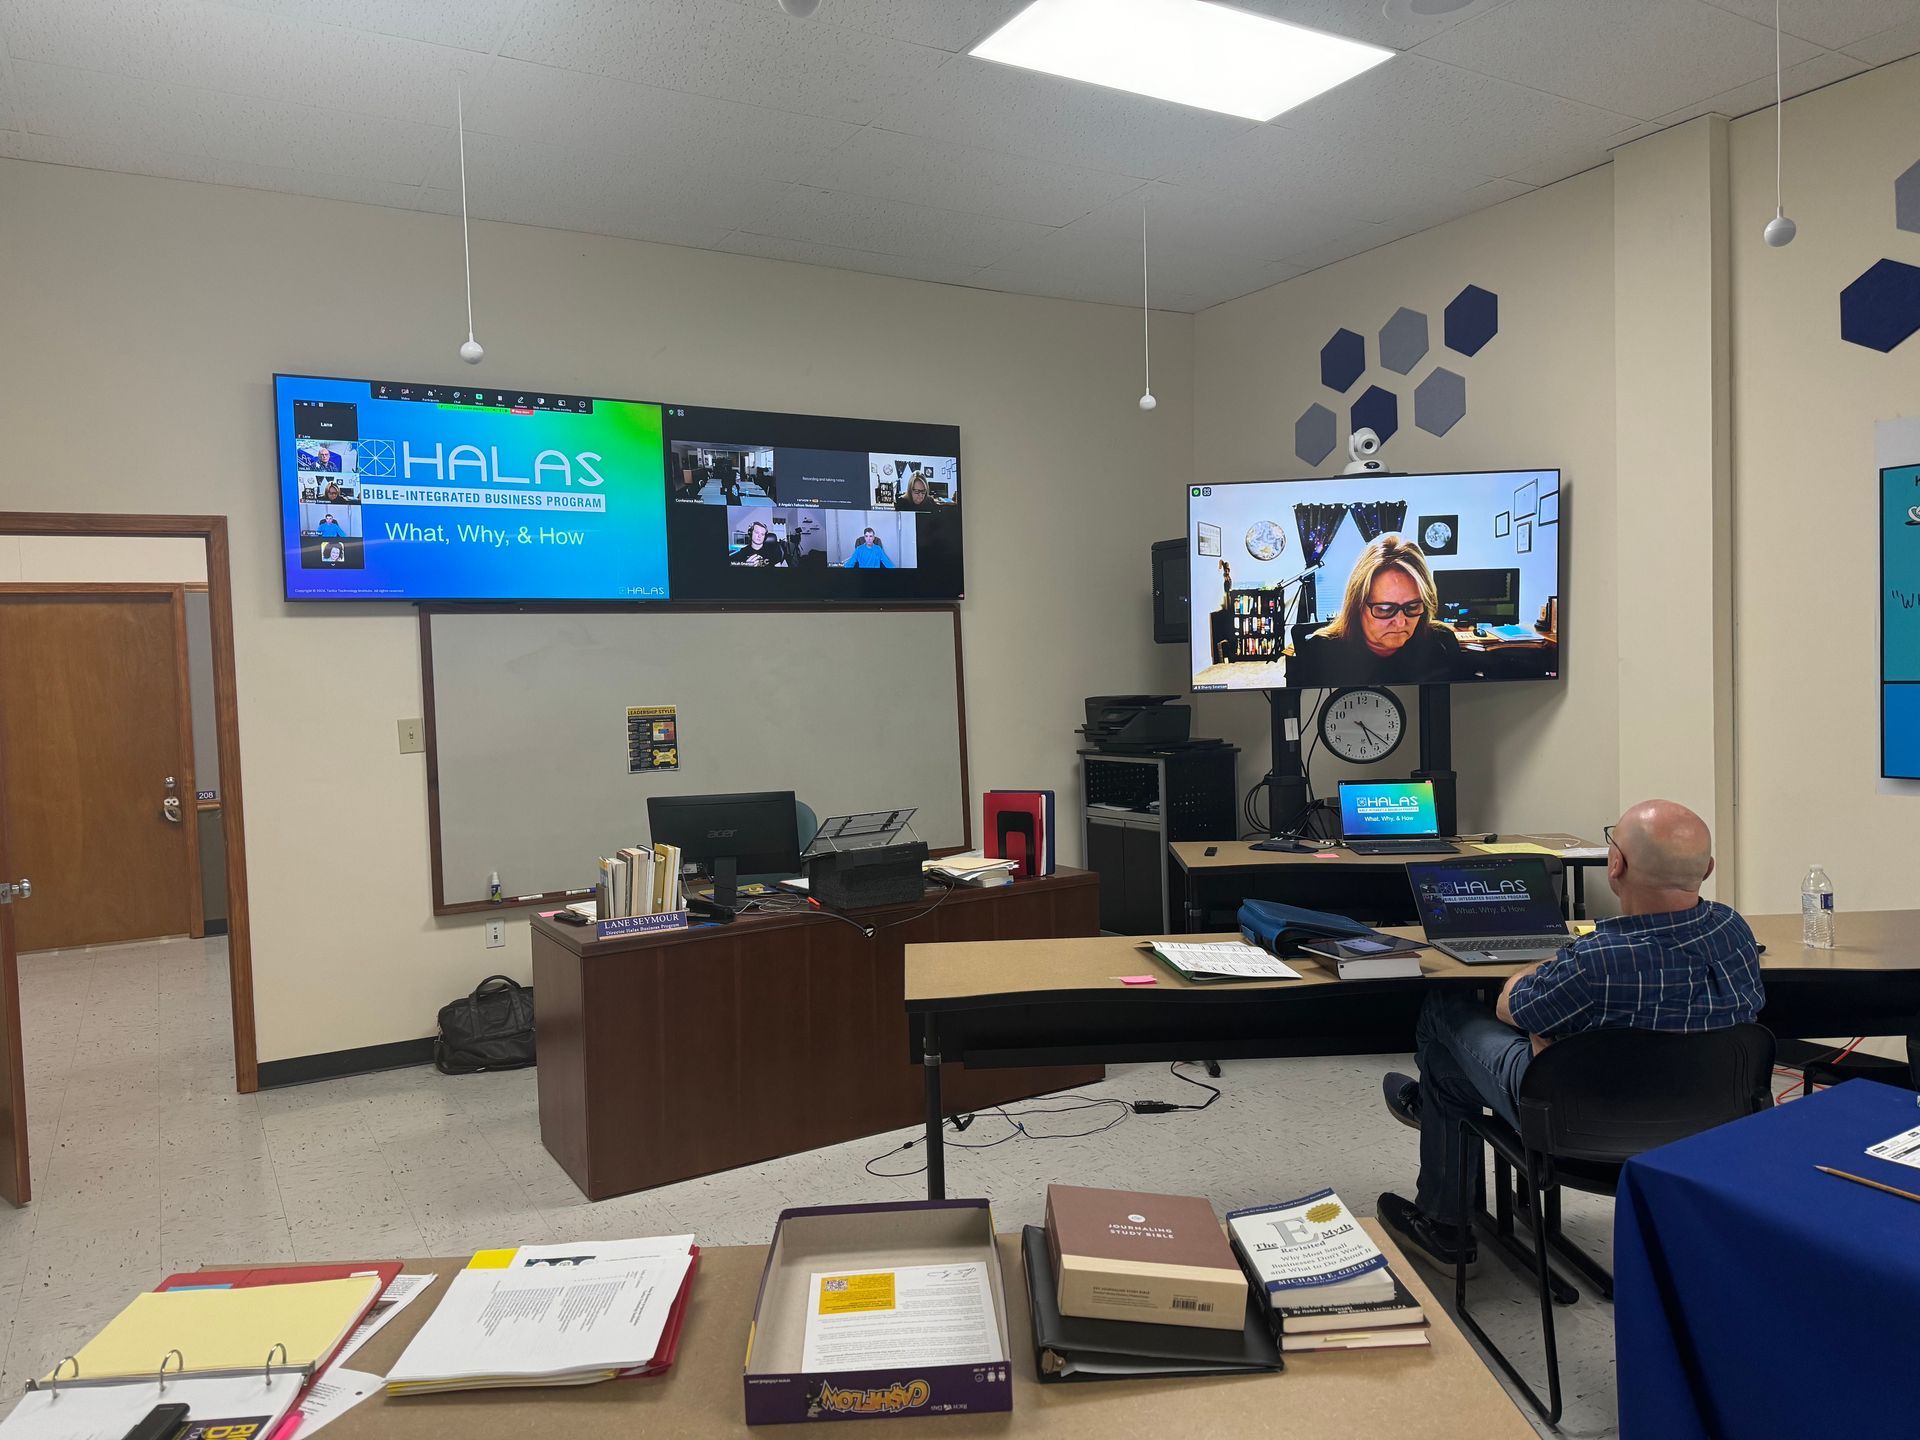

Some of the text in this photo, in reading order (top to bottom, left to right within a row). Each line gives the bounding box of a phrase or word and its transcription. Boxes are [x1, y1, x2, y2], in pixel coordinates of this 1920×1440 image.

[402, 440, 604, 487] HALAS
[362, 488, 602, 509] BIBLE-INTEGRATED BUSINESS PROGRAM
[385, 522, 585, 548] What, Why, & How
[627, 586, 665, 595] HALAS
[1344, 700, 1353, 709] 11
[1357, 696, 1368, 705] 12
[1335, 711, 1346, 720] 10
[1384, 709, 1391, 718] 2
[1330, 723, 1336, 732] 9
[1388, 720, 1394, 728] 3
[1347, 744, 1352, 752] 7
[1360, 746, 1366, 754] 6
[1373, 743, 1380, 751] 5
[1367, 796, 1418, 806] HALAS
[708, 829, 738, 839] acer
[1453, 880, 1527, 895] HALAS
[604, 913, 680, 929] LANE SEYMOUR
[1108, 1223, 1173, 1234] JOURNALING
[1253, 1216, 1352, 1250] The E Myth
[1281, 1240, 1326, 1253] Revisited
[1272, 1245, 1363, 1269] Businesses Don't Work
[1281, 1243, 1347, 1263] Why Most Small
[1288, 1265, 1312, 1273] What
[1323, 1259, 1337, 1267] Do
[1339, 1252, 1363, 1264] About
[1278, 1275, 1323, 1286] MICHAEL
[1338, 1258, 1378, 1275] GERBER
